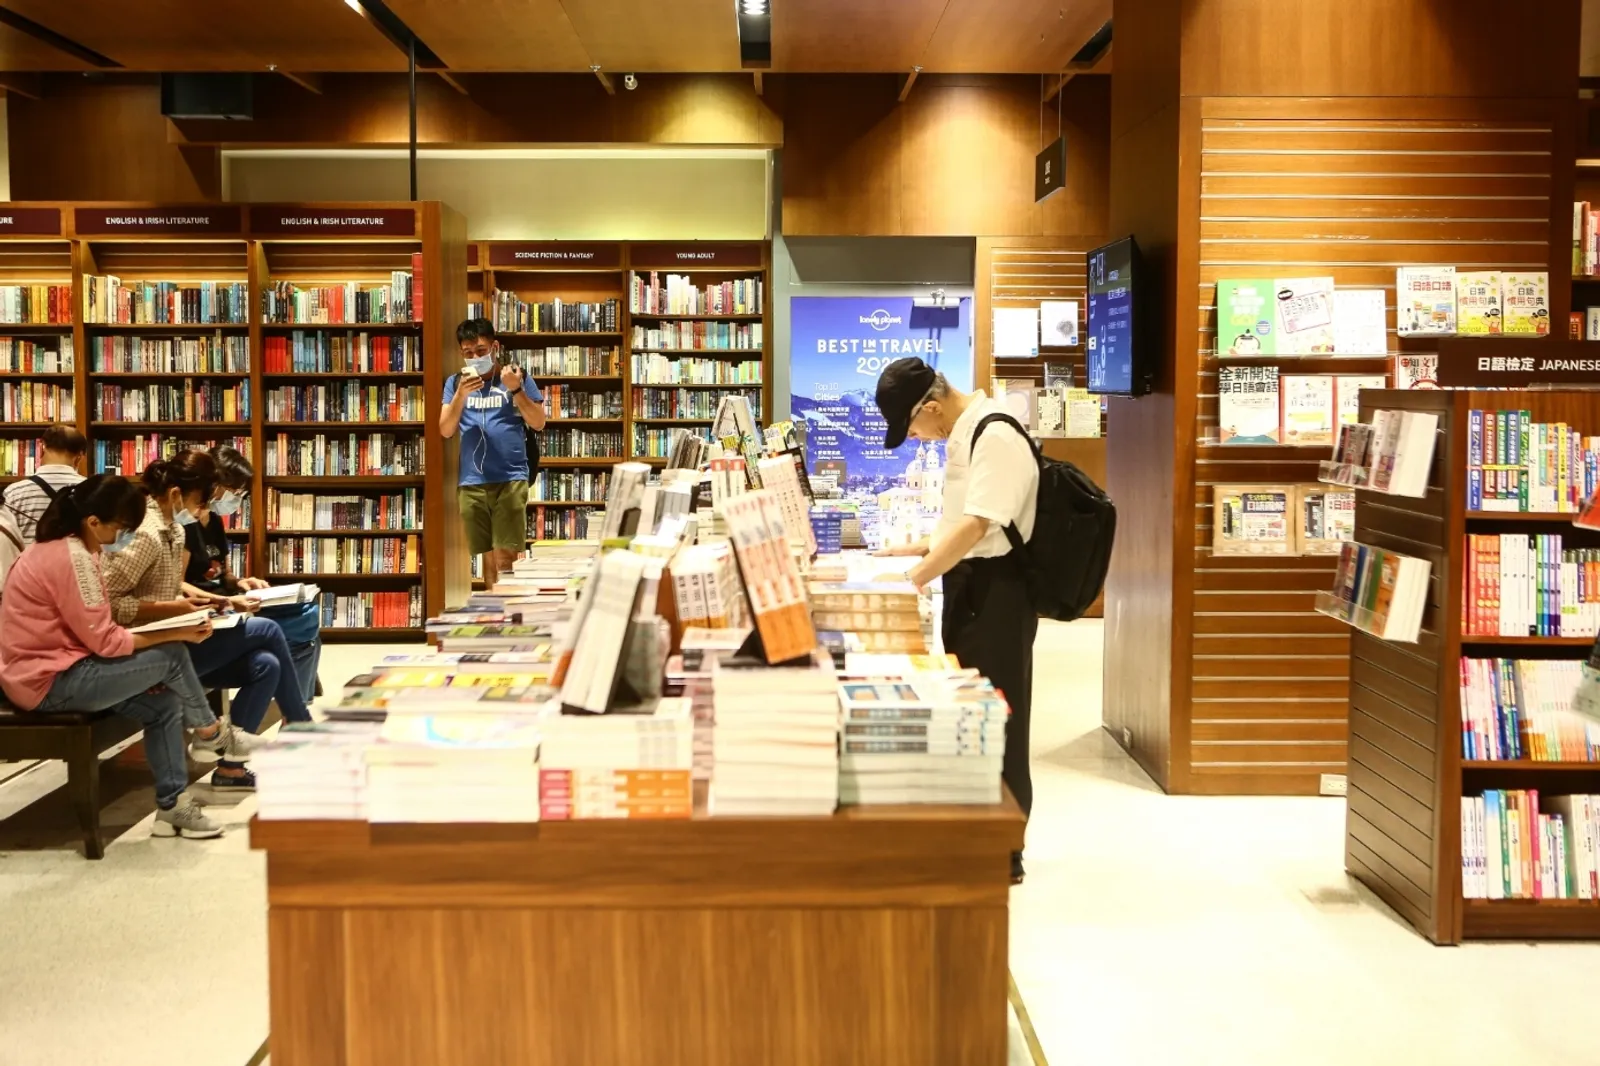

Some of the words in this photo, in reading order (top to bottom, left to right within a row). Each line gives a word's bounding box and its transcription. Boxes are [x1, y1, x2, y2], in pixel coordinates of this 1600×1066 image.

[105, 217, 138, 225] ENGLISH
[138, 217, 144, 225] &
[145, 217, 165, 225] IRISH
[166, 217, 210, 225] LITERATURE
[281, 217, 312, 225] ENGLISH
[313, 217, 319, 225] &
[320, 217, 340, 225] IRISH
[341, 217, 384, 225] LITERATURE
[859, 315, 880, 325] lonely
[880, 315, 902, 325] planet
[817, 339, 859, 353] BEST
[863, 339, 877, 349] IN
[878, 339, 944, 353] TRAVEL
[856, 357, 902, 376] 202
[1477, 356, 1535, 371] 日語檢定
[1539, 359, 1600, 371] JAPANESE
[1219, 367, 1278, 381] 全新開始
[814, 382, 829, 391] Top
[830, 382, 839, 390] 10
[466, 395, 503, 409] PUMA
[814, 393, 841, 402] Cities
